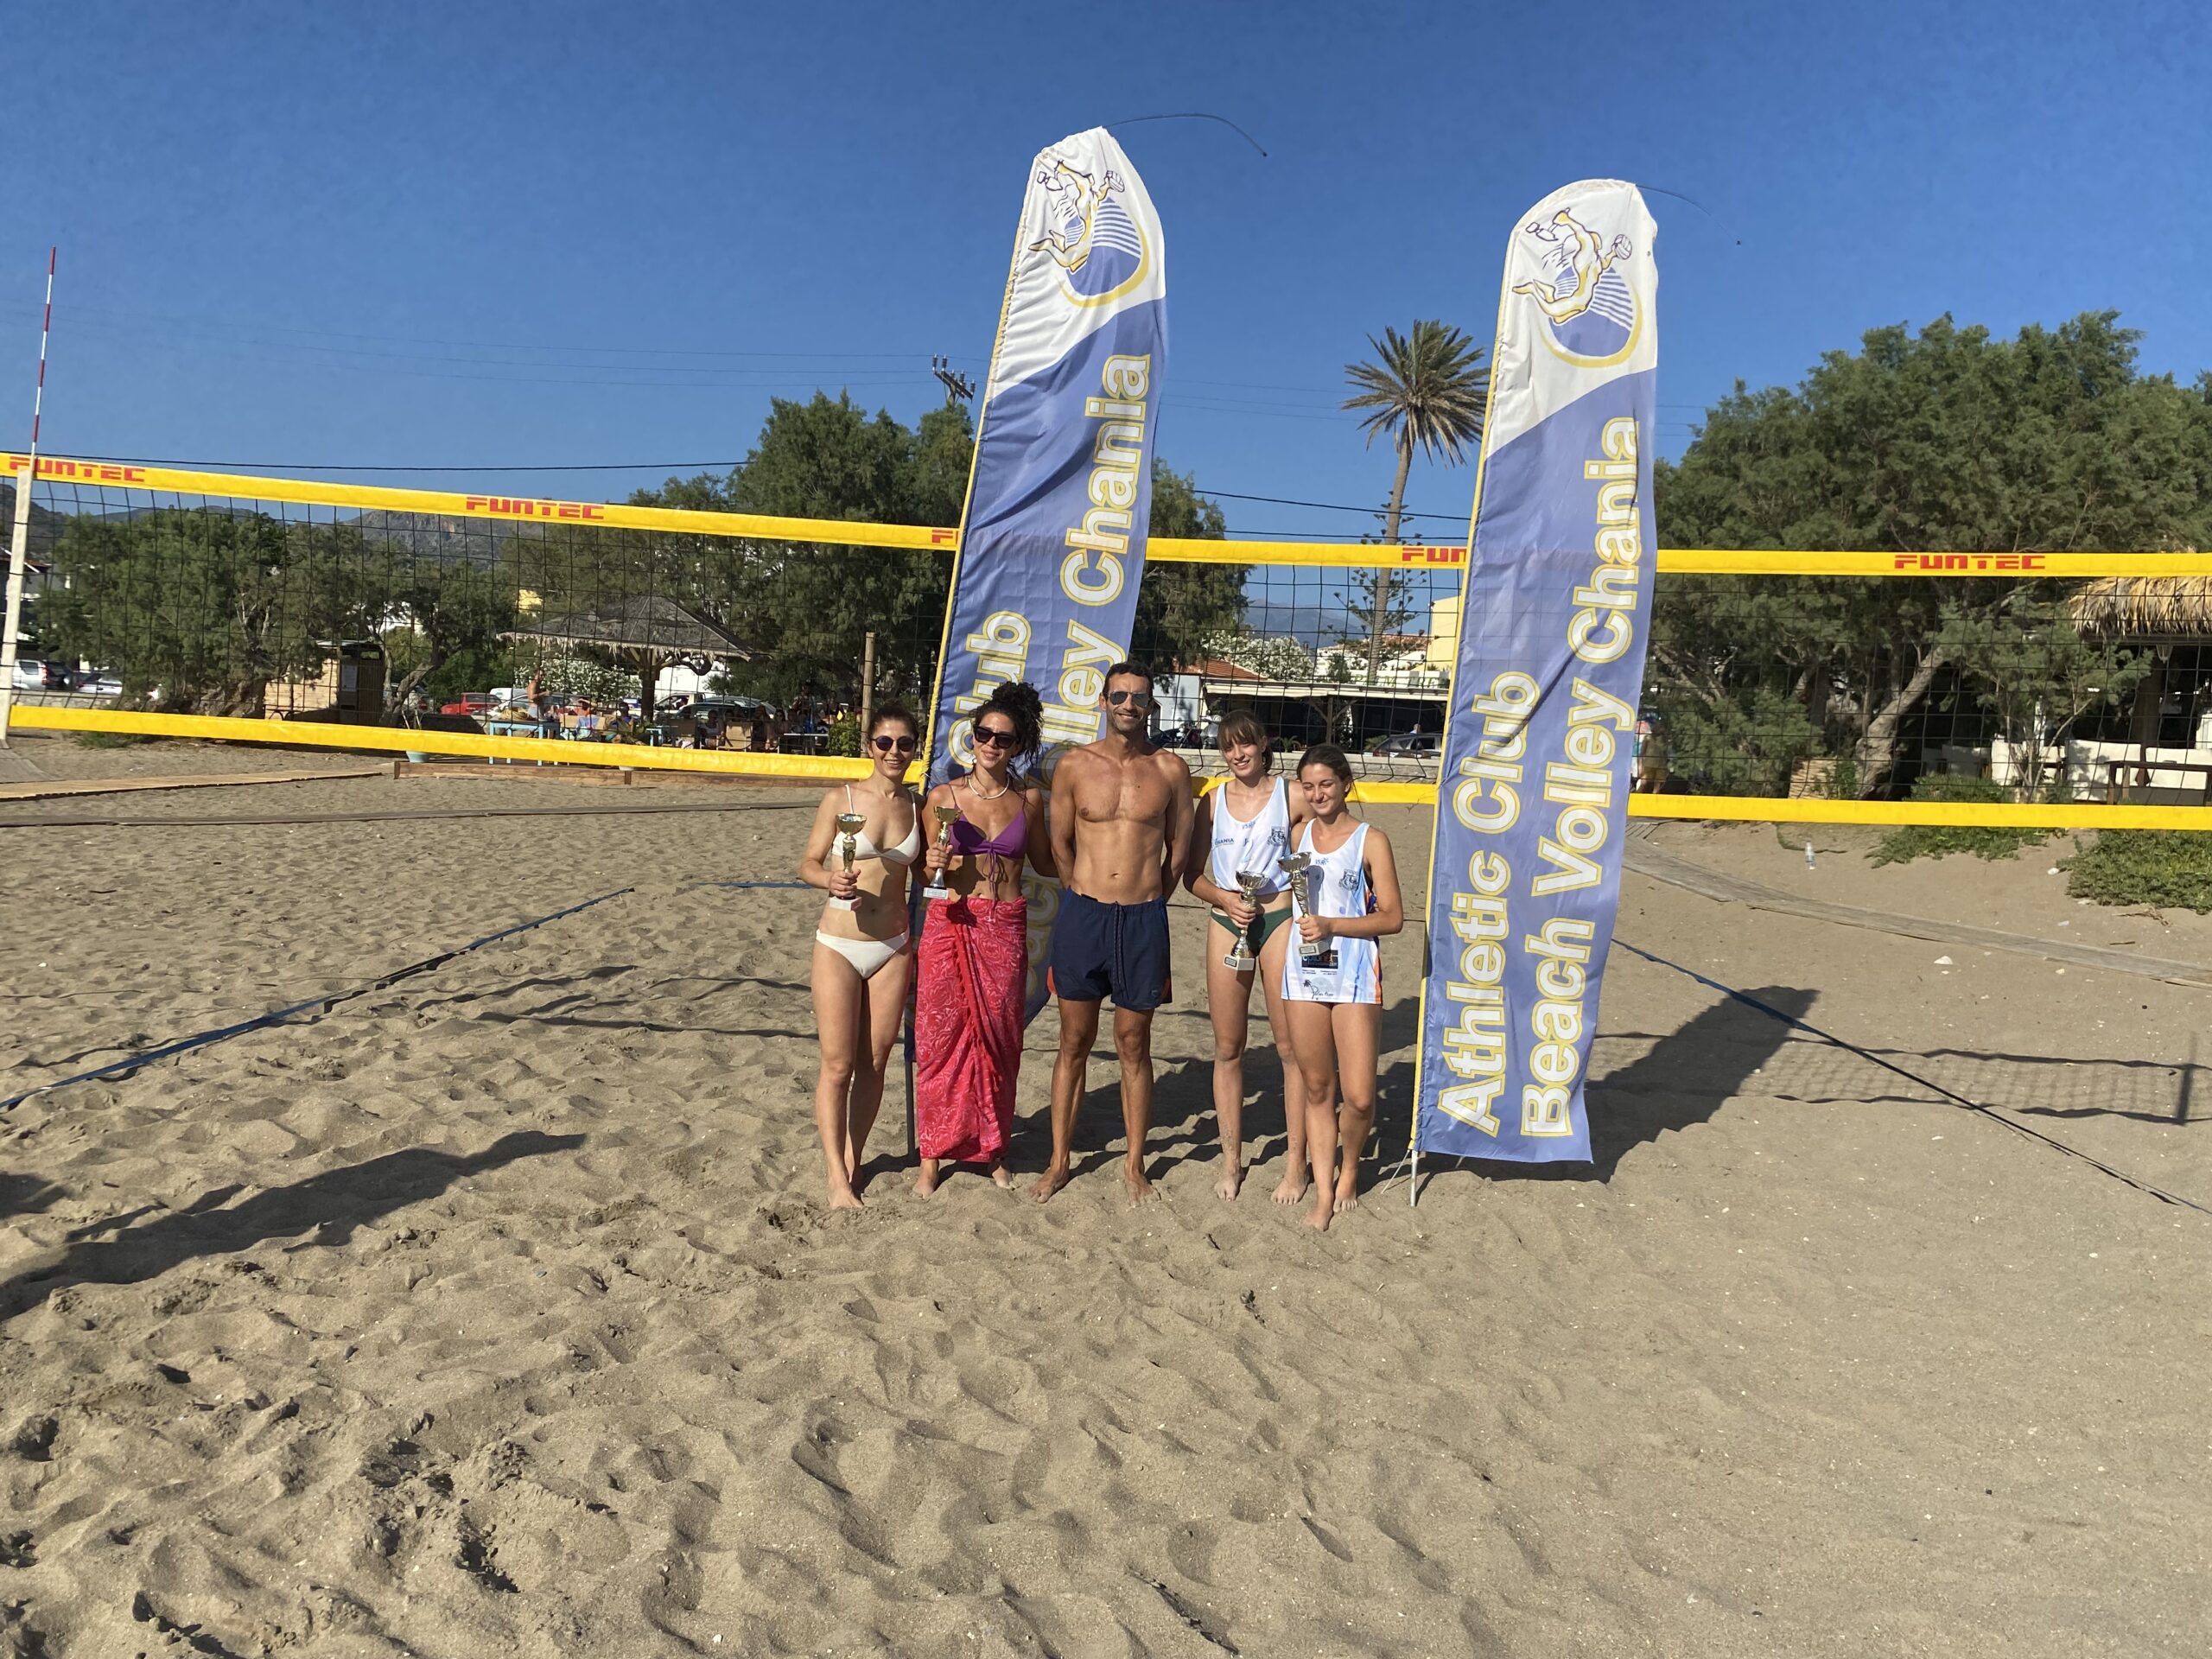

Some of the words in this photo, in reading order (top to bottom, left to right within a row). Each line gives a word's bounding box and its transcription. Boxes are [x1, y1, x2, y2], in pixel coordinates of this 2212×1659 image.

[10, 455, 145, 482] FUNTEC
[467, 496, 604, 519] FUNTEC
[1060, 353, 1151, 607] Chania
[1567, 416, 1643, 664] Chania
[1895, 555, 2045, 569] FUNTEC
[1452, 671, 1541, 834] Club
[1531, 677, 1636, 896] Volley
[1438, 850, 1511, 1138] Athletic
[1521, 918, 1596, 1137] Beach
